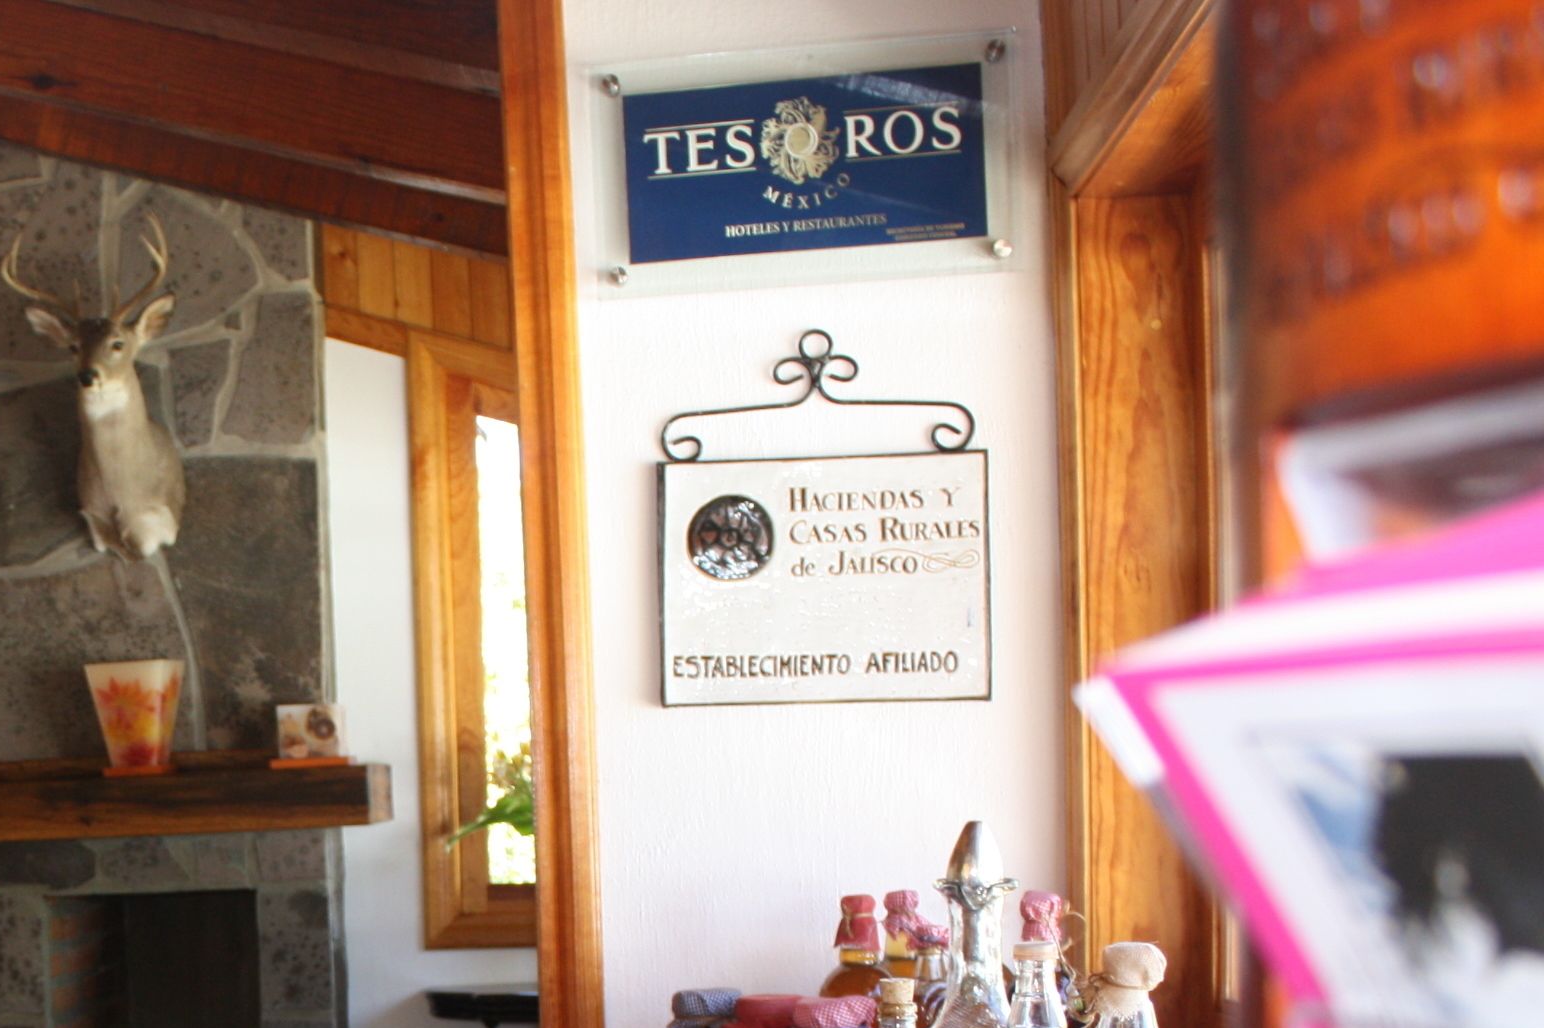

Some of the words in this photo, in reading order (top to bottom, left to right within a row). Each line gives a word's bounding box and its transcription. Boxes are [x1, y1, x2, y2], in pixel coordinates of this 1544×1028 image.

[724, 222, 781, 238] HOTELES
[782, 221, 790, 233] Y
[793, 213, 887, 232] RESTAURANTES
[940, 487, 961, 507] Y
[791, 556, 815, 577] de
[673, 655, 851, 679] ESTABLECIMIENTO
[865, 651, 959, 673] AFILIADO
